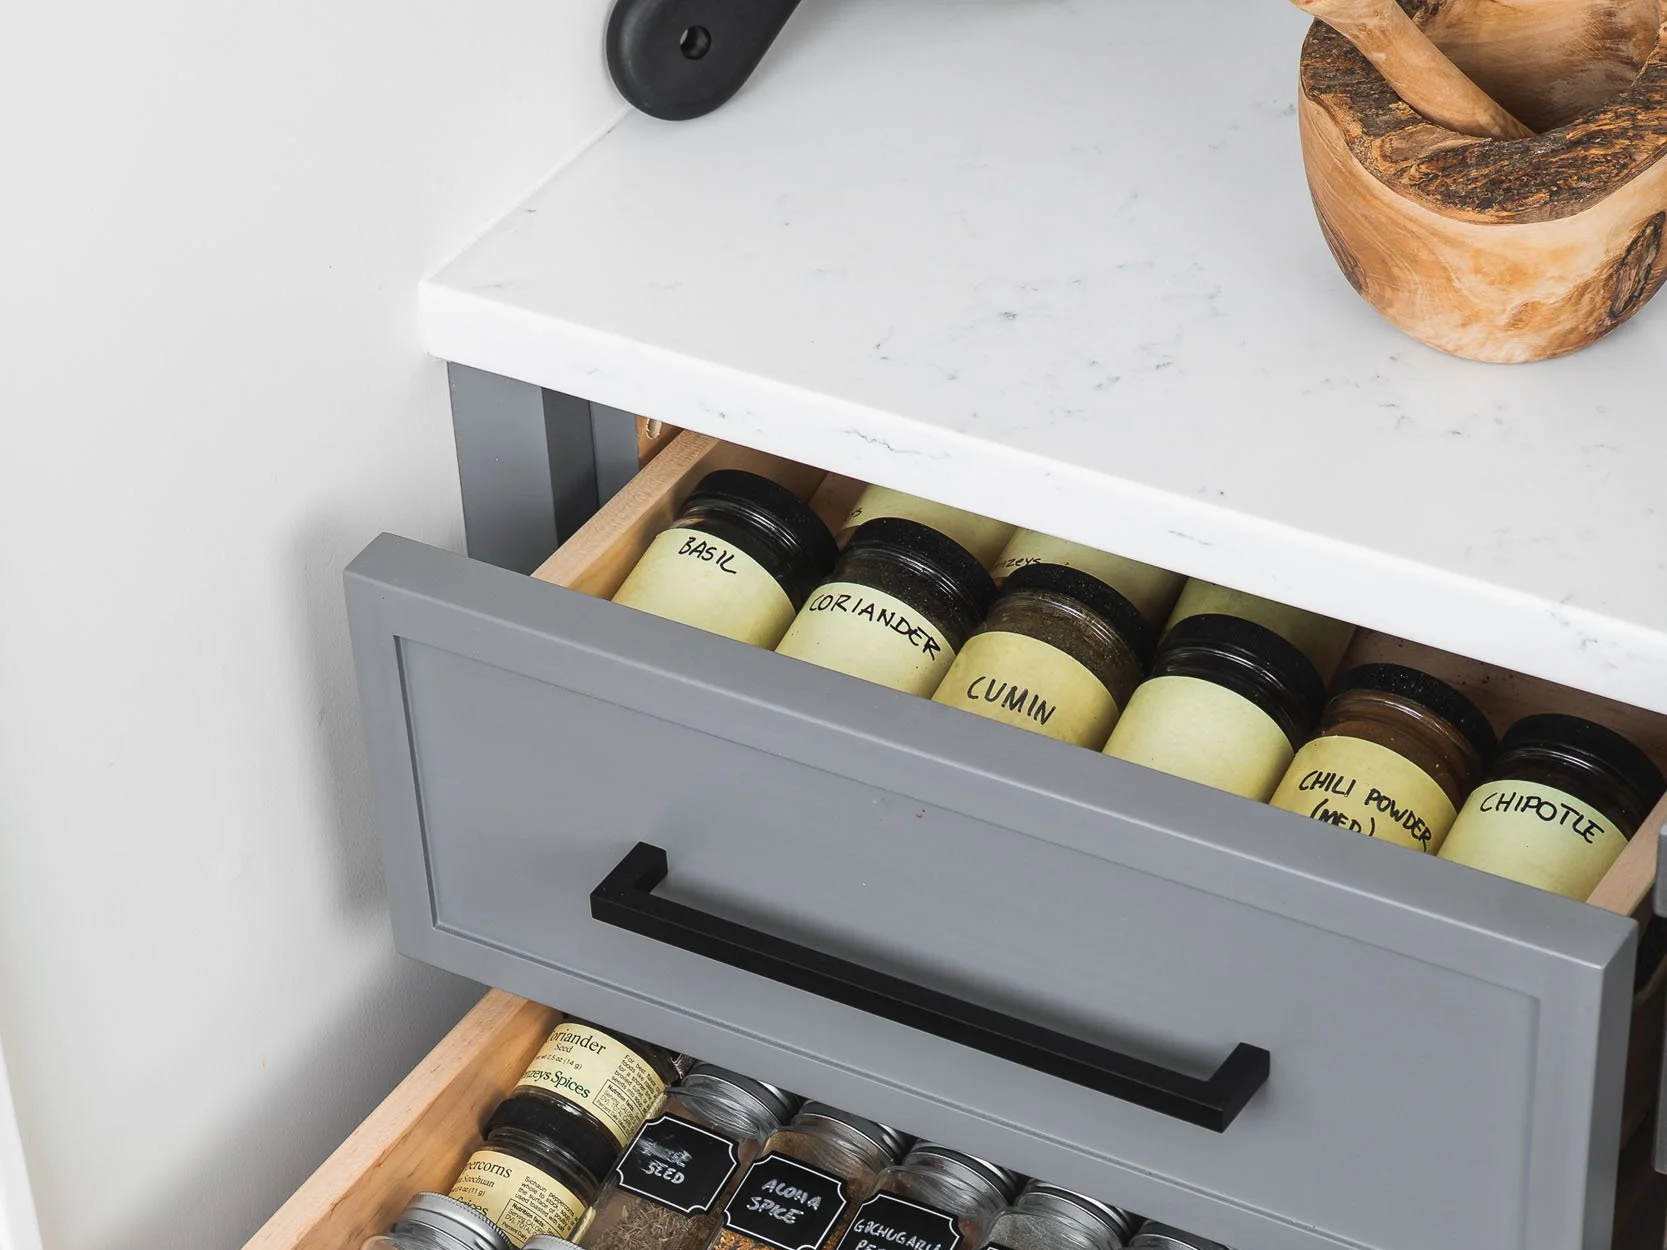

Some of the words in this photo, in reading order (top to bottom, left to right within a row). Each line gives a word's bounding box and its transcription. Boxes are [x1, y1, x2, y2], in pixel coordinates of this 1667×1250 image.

[678, 536, 736, 574] BASIL
[809, 594, 941, 661] CORIANDER
[967, 674, 1057, 726] CUMIN
[1299, 770, 1356, 797] CHILI
[1364, 788, 1432, 852] POWDER
[1479, 791, 1604, 846] CHIPOTLE
[550, 1028, 607, 1055] oriander
[551, 1070, 591, 1098] Spices
[640, 1160, 685, 1184] SEED
[746, 1196, 804, 1224] SPICE
